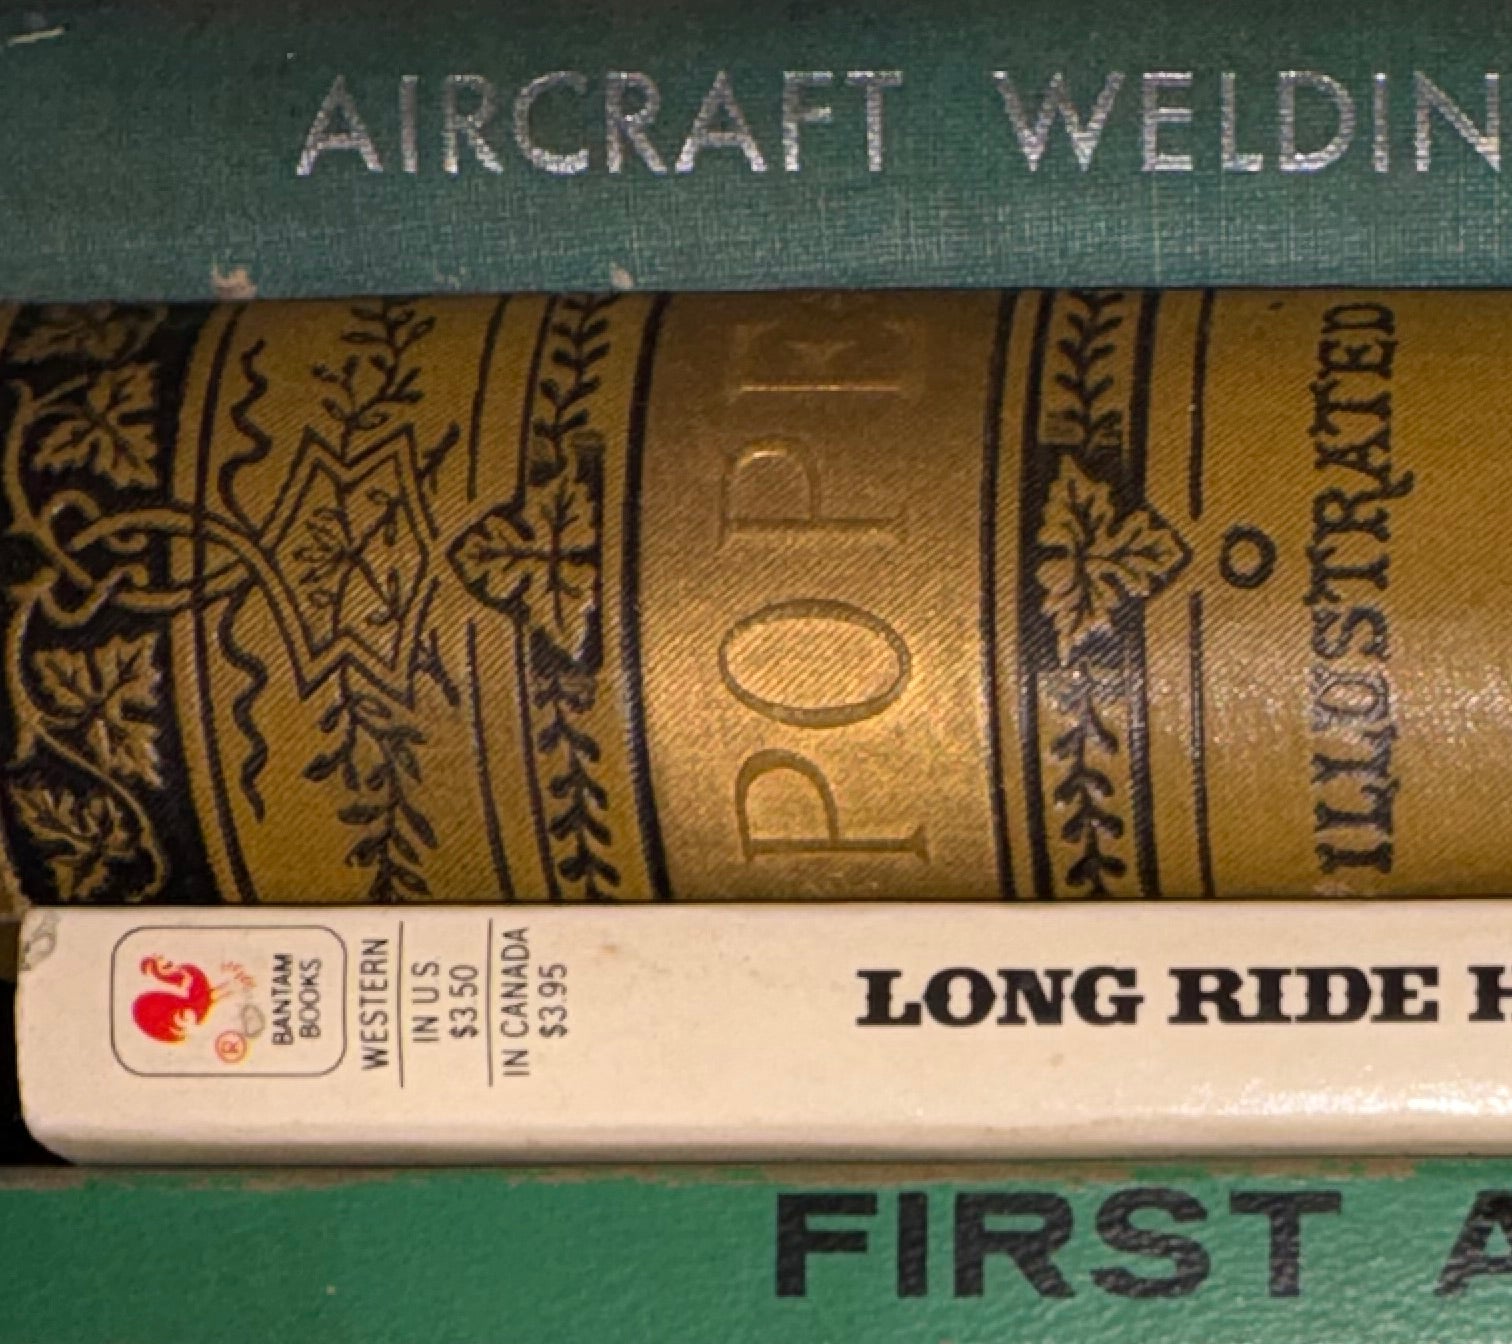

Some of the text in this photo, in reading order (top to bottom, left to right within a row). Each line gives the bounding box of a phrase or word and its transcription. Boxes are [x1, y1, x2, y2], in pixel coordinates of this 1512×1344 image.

[295, 70, 904, 177] AIRCRAFT
[715, 314, 931, 866] POPE
[1304, 301, 1416, 876] ILLUSTRATED
[271, 952, 295, 1046] BANTAM
[298, 957, 322, 1039] BOOKS
[358, 938, 390, 1071] WESTERN
[411, 1015, 440, 1044] IN
[500, 927, 531, 1078] IN CANADA
[537, 963, 569, 1039] $3.95
[855, 967, 1144, 1027] LONG
[1167, 964, 1440, 1026] RIDE
[772, 1185, 1344, 1299] FIRST
